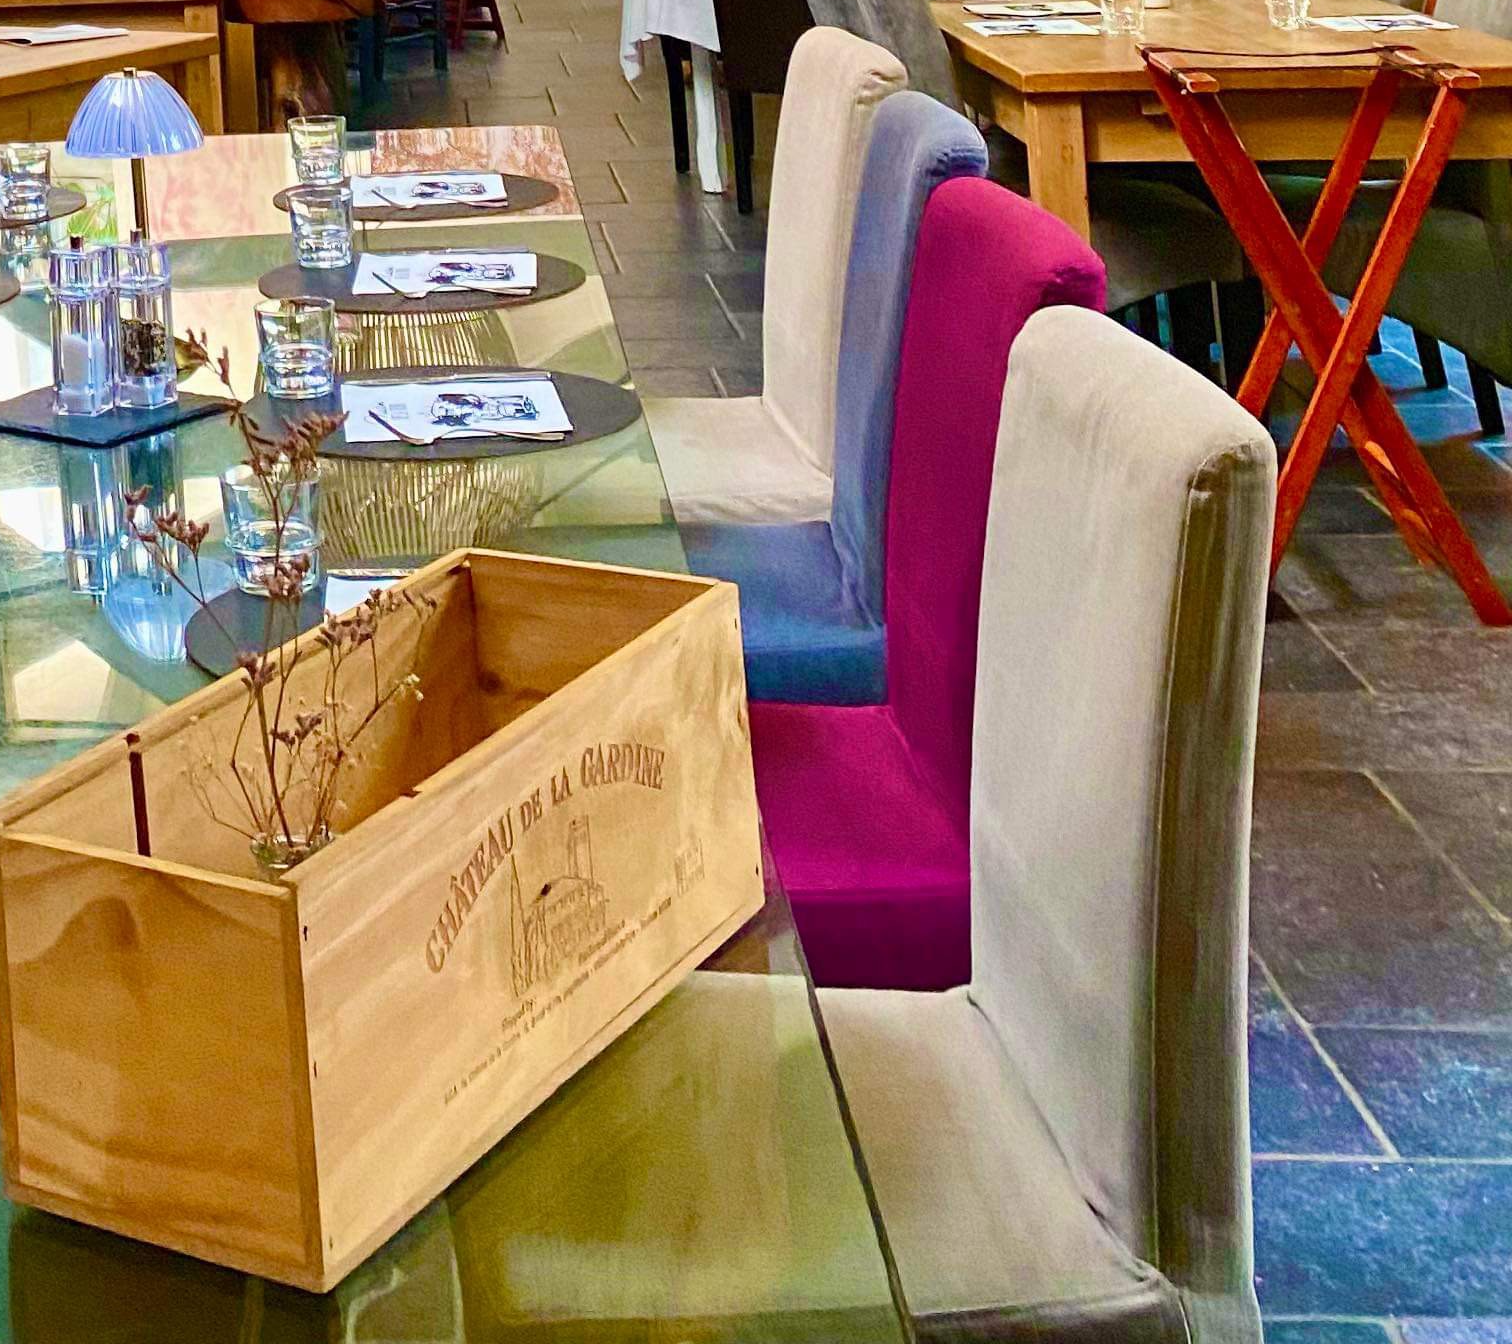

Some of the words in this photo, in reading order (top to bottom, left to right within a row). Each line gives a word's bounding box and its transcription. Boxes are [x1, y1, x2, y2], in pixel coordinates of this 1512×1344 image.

[426, 808, 514, 974] CHÂTEAU
[519, 787, 543, 833] DE
[550, 765, 573, 806] LA
[580, 743, 665, 790] GARDINE
